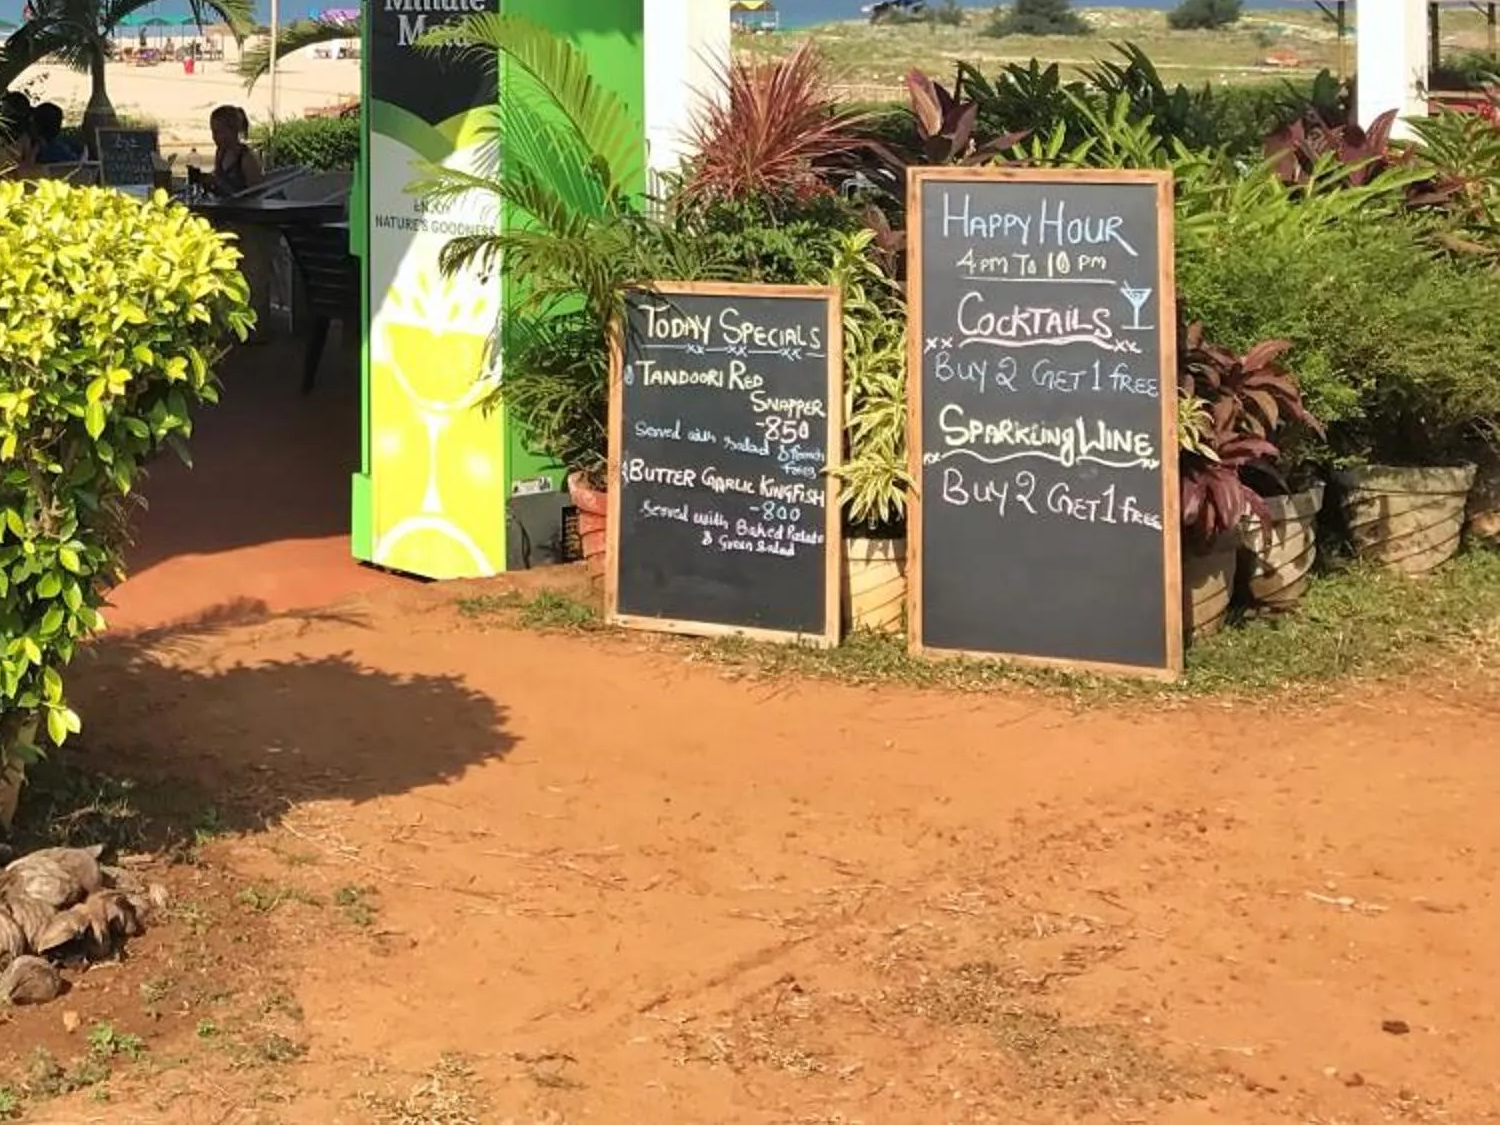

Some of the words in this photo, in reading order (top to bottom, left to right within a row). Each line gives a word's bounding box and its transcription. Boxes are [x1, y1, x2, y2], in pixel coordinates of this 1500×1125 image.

[397, 14, 473, 48] Md
[943, 192, 1031, 246] HAPPY
[1038, 198, 1139, 256] HOUR
[1047, 250, 1071, 277] 10
[996, 356, 1018, 392] 2
[1091, 359, 1101, 391] 1
[629, 458, 697, 489] BUTTER
[1015, 470, 1038, 514] 2
[1100, 483, 1117, 524] 1
